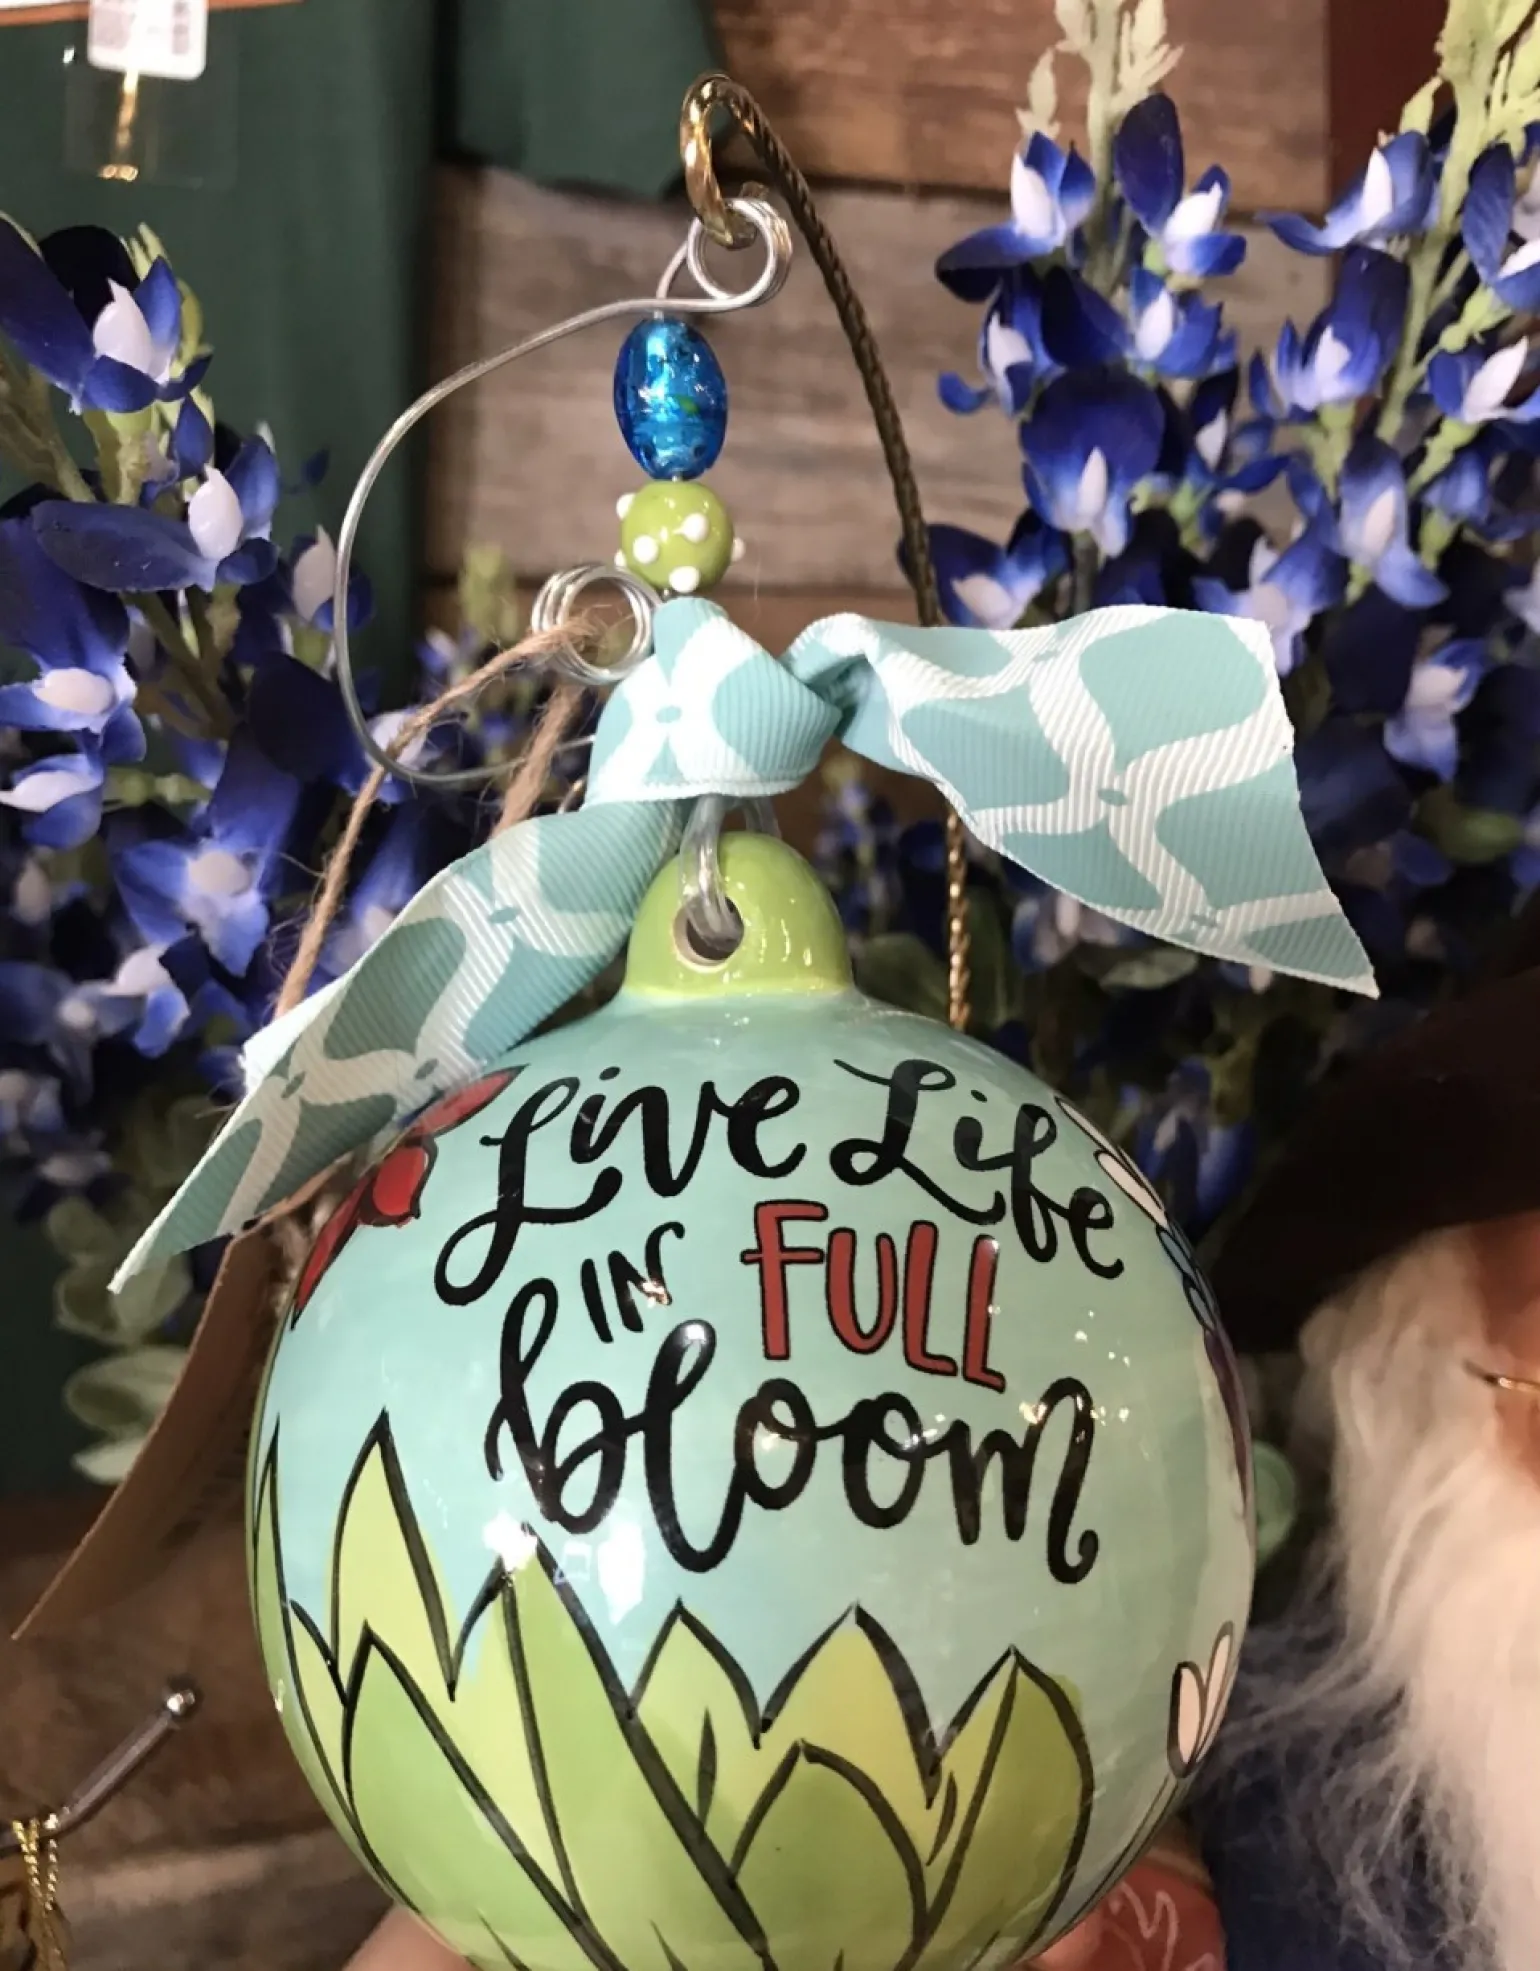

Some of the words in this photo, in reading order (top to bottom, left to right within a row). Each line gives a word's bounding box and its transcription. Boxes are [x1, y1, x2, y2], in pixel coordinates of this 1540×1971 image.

[435, 1067, 806, 1305] Live
[830, 1059, 1124, 1278] Life
[581, 1221, 685, 1343] IN
[741, 1200, 1006, 1393] FULL
[485, 1278, 1098, 1584] bloom
